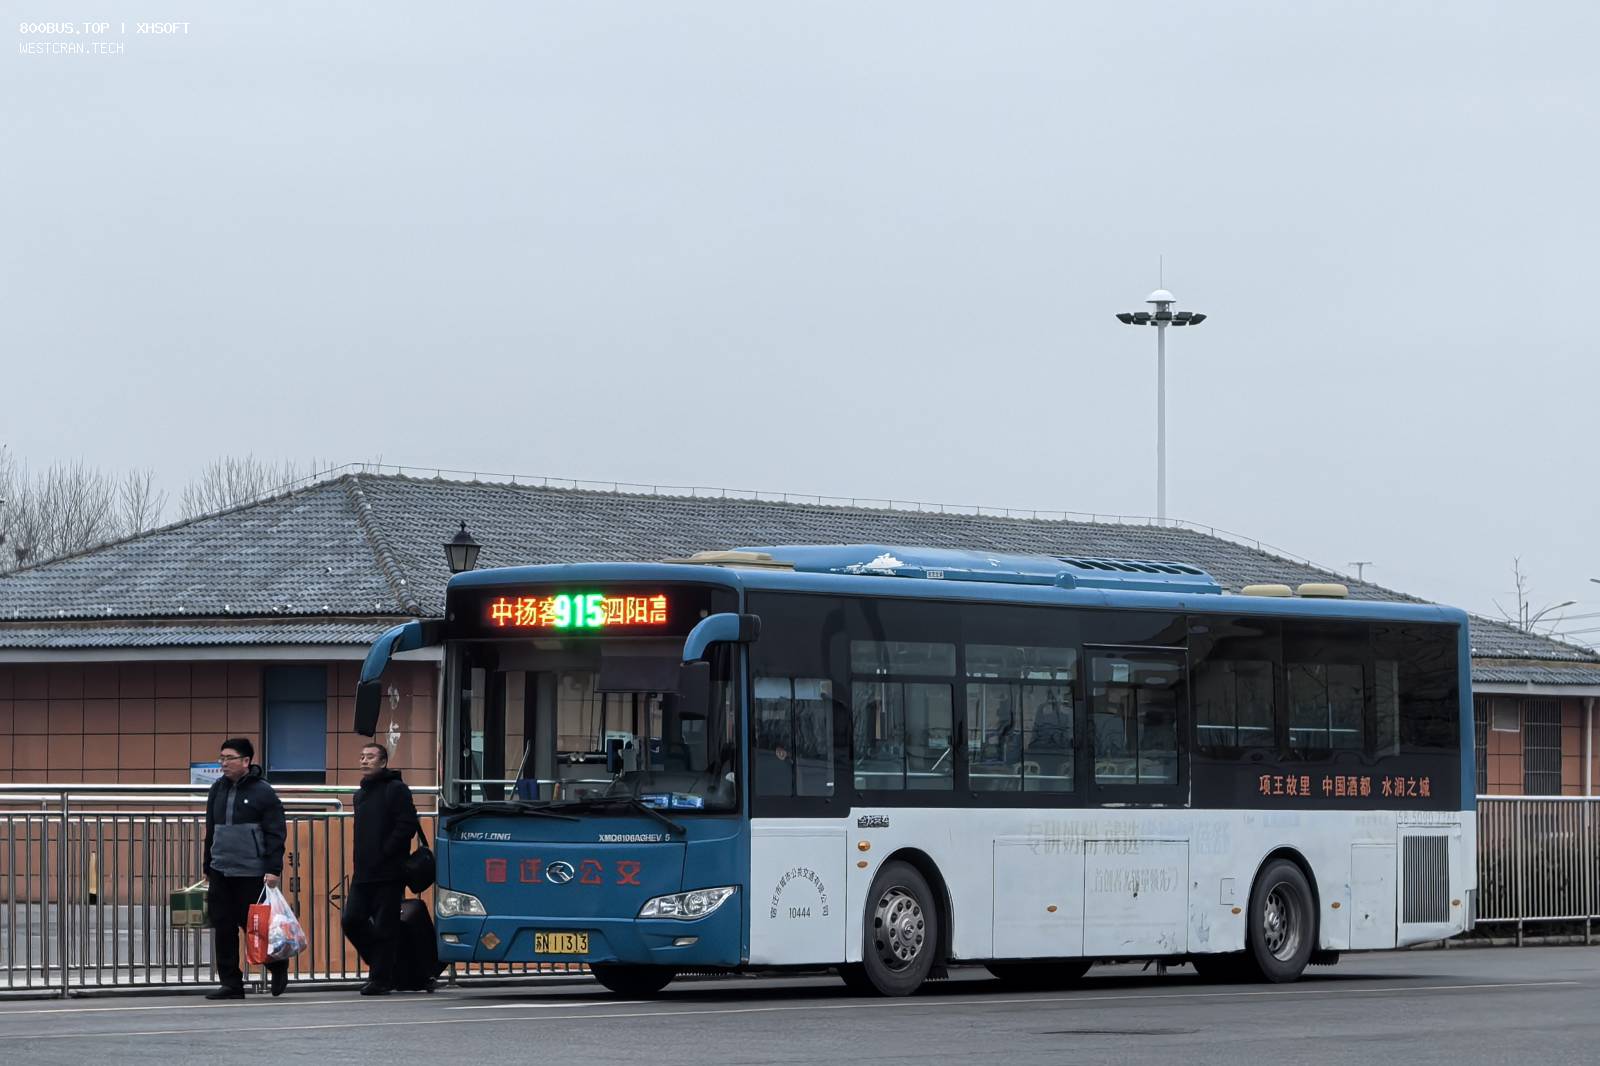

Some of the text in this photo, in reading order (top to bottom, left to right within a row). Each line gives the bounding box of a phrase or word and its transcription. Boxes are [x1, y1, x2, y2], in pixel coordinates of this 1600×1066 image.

[554, 594, 605, 627] 915
[1259, 774, 1311, 797] 项王故里
[1322, 775, 1371, 797] 中国酒都
[460, 832, 511, 841] KING LONG
[579, 859, 641, 885] 公交
[789, 907, 811, 919] 10444
